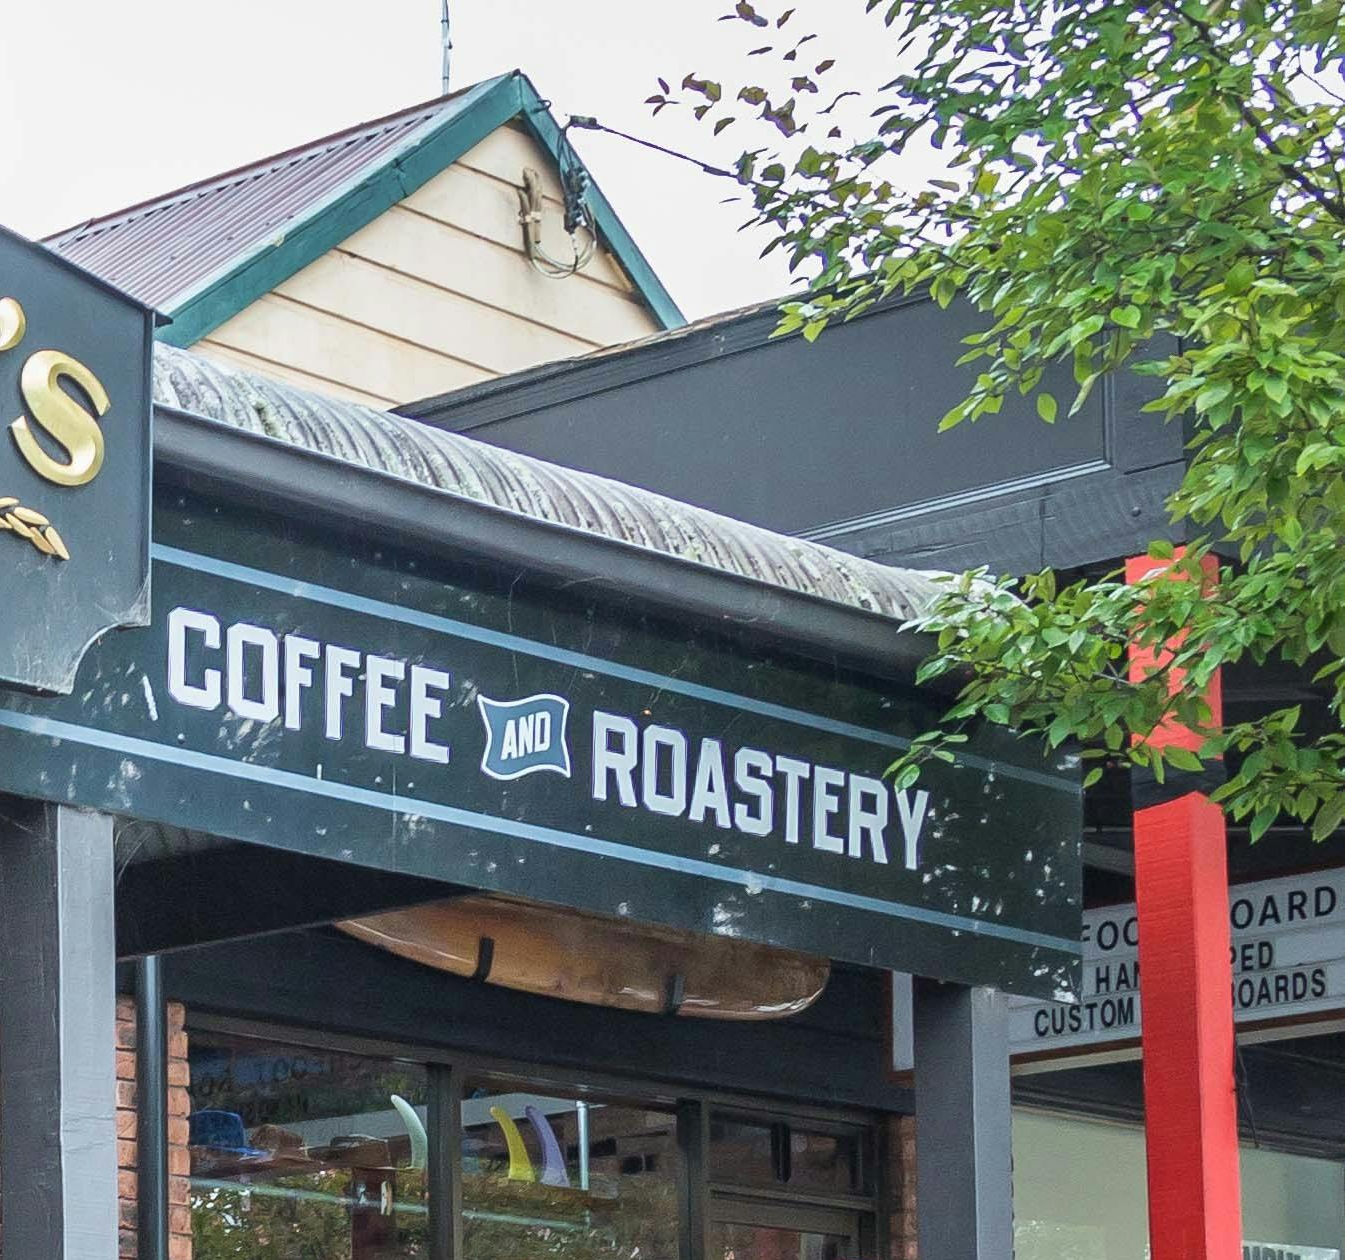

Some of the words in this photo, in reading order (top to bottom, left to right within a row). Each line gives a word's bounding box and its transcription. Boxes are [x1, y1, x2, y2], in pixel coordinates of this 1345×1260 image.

[165, 605, 451, 763] COFFEE
[500, 710, 552, 761] AND
[591, 710, 930, 871] ROASTERY
[1231, 885, 1337, 929] OARD
[1034, 997, 1135, 1038] CUSTOM
[1231, 968, 1326, 1008] OARDS
